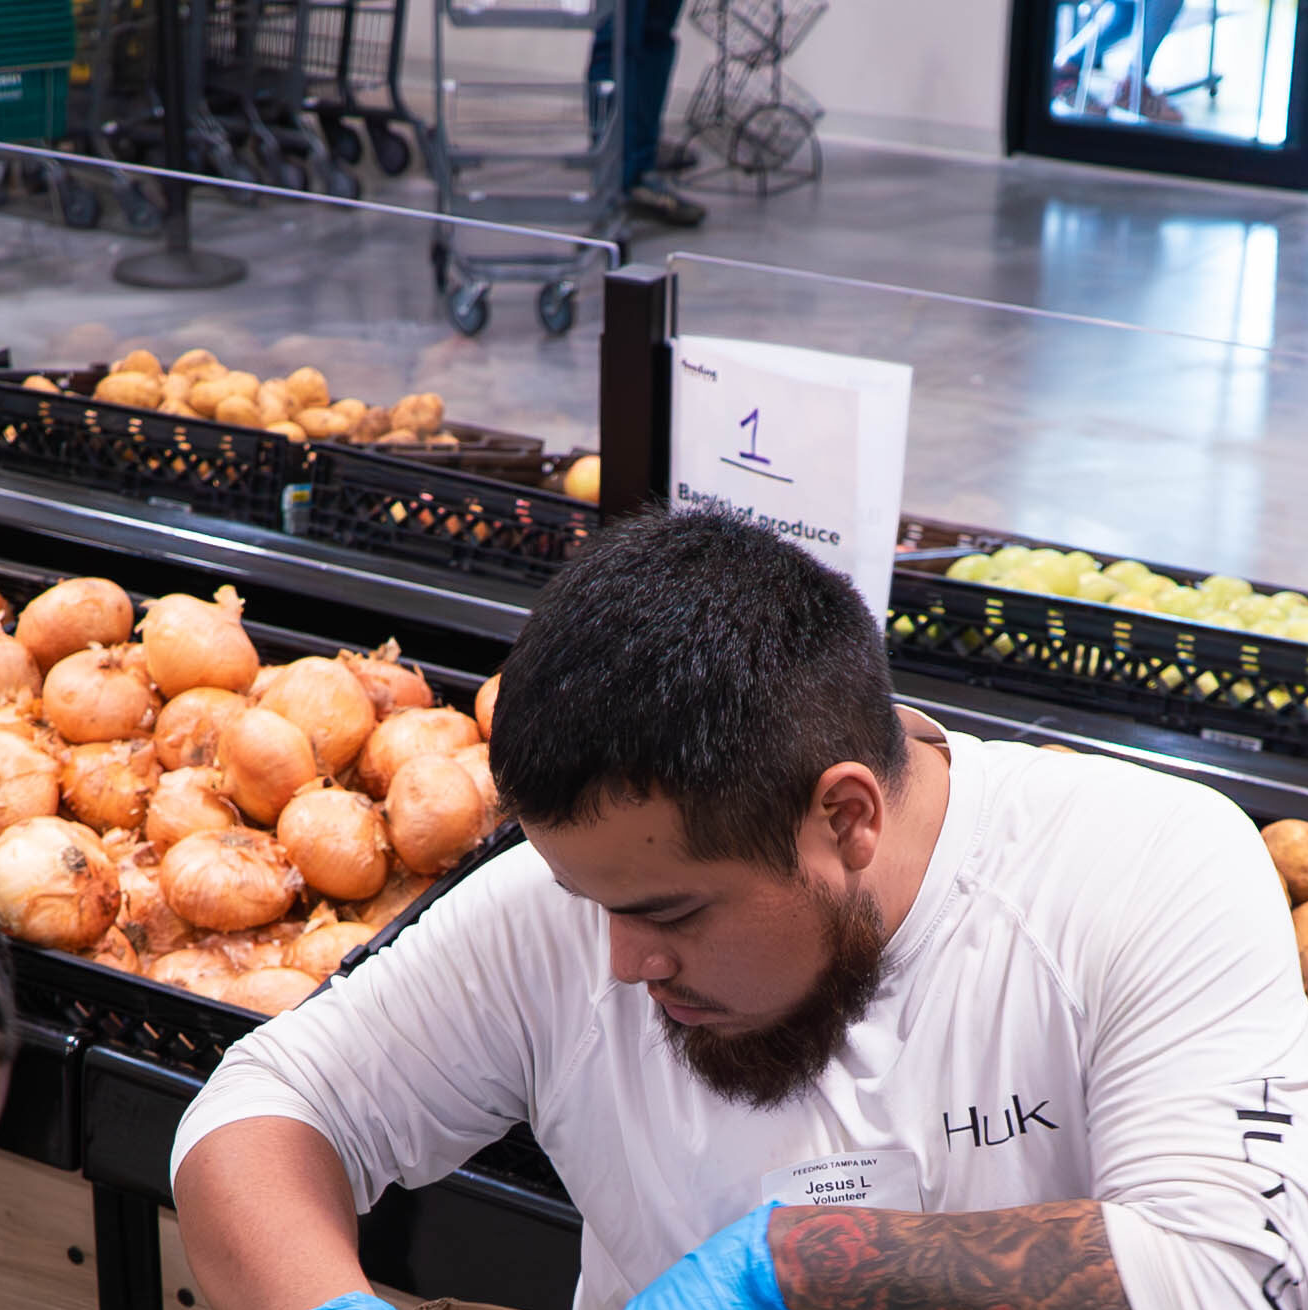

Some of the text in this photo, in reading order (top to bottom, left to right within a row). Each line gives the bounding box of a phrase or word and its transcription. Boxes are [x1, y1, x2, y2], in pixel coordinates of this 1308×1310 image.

[739, 407, 771, 465] 1
[758, 514, 841, 546] produce
[792, 1158, 878, 1177] FEEDING TAMPA BAY
[805, 1175, 872, 1195] Jesus L
[812, 1191, 867, 1206] Volunteer
